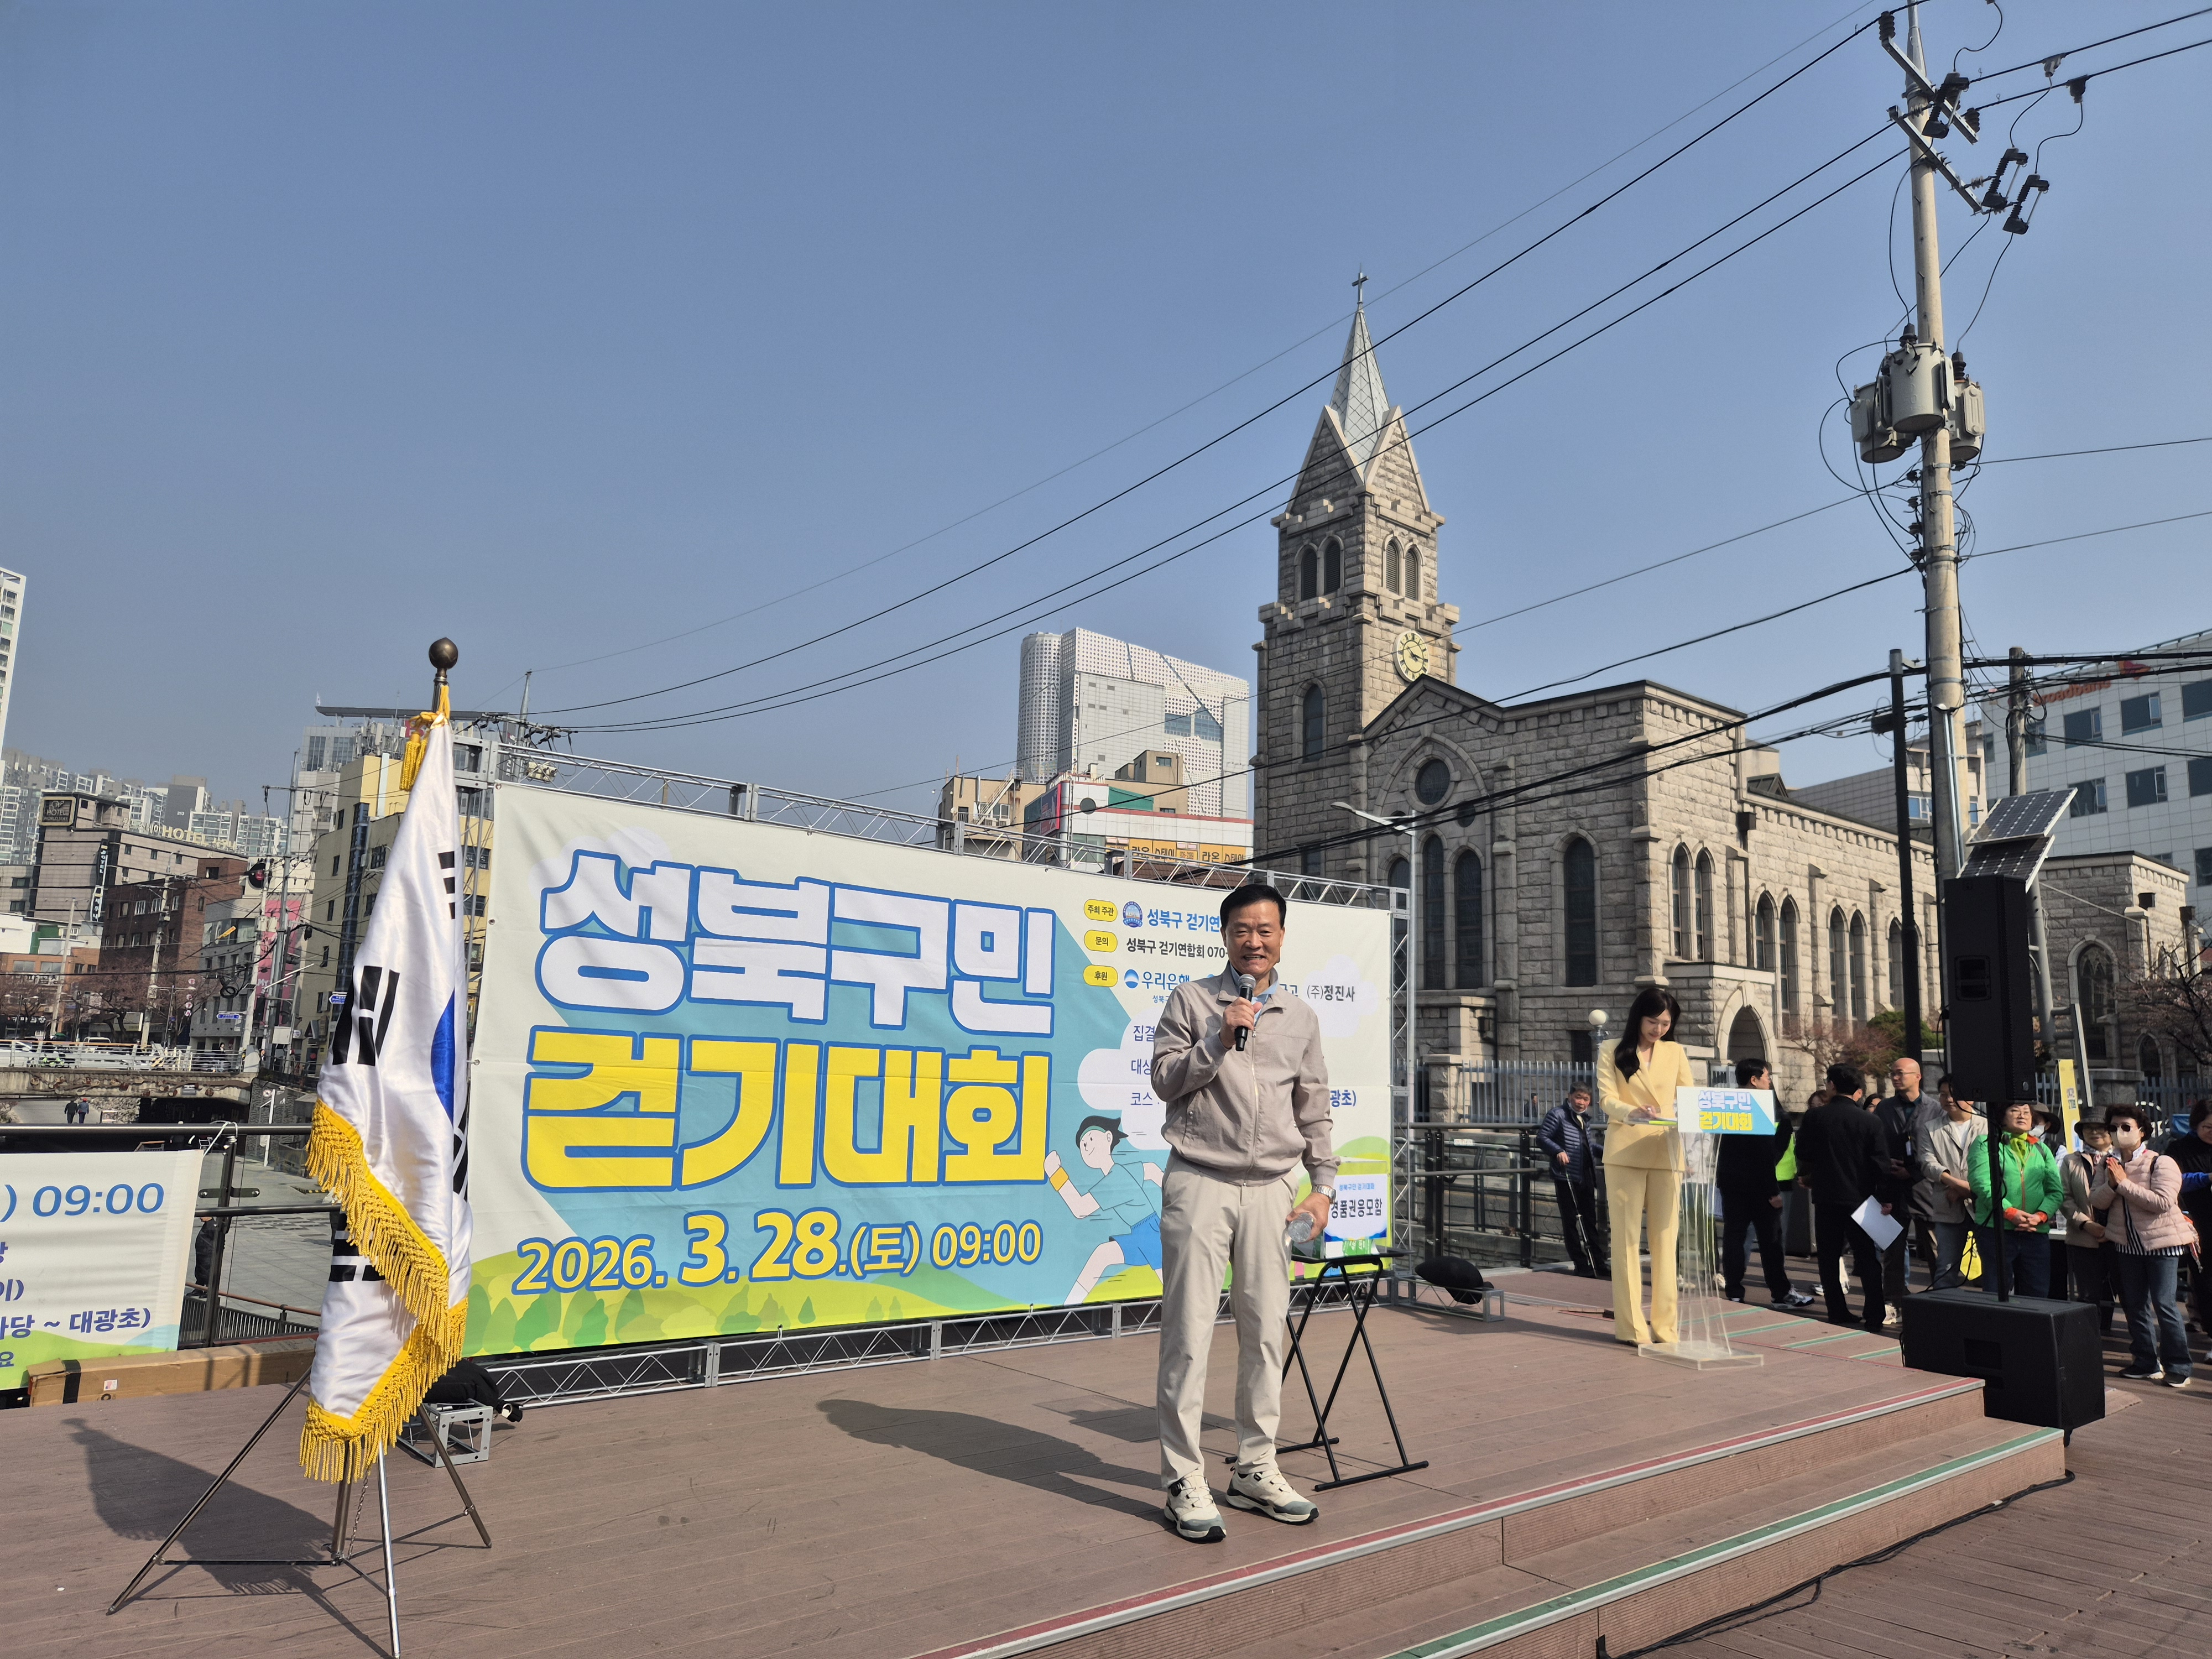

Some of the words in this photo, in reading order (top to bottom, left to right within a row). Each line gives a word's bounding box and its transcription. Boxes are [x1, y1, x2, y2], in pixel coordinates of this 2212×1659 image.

[162, 825, 209, 847] HOTEL
[1202, 852, 1219, 863] 라온
[1087, 905, 1100, 915] 주최
[1102, 906, 1114, 916] 주관
[1147, 909, 1183, 929] 성북구
[535, 849, 1056, 1038] 성북구민
[1095, 936, 1109, 946] 문의
[1126, 938, 1156, 954] 성북구
[1159, 941, 1205, 958] 걷기연합회
[1094, 971, 1108, 981] 후원
[1307, 984, 1355, 1002] (주)정진사
[1133, 1025, 1155, 1042] 집결
[1130, 1092, 1153, 1105] 코스
[1698, 1090, 1751, 1110] 성북구민
[520, 1025, 1052, 1193] 걷기대회
[1699, 1111, 1752, 1131] 걷기대회
[32, 1182, 164, 1217] 09:00
[512, 1234, 667, 1295] 2026.
[679, 1210, 739, 1287] 3.
[930, 1219, 1044, 1269] 09:00
[69, 1308, 151, 1334] 대광초)
